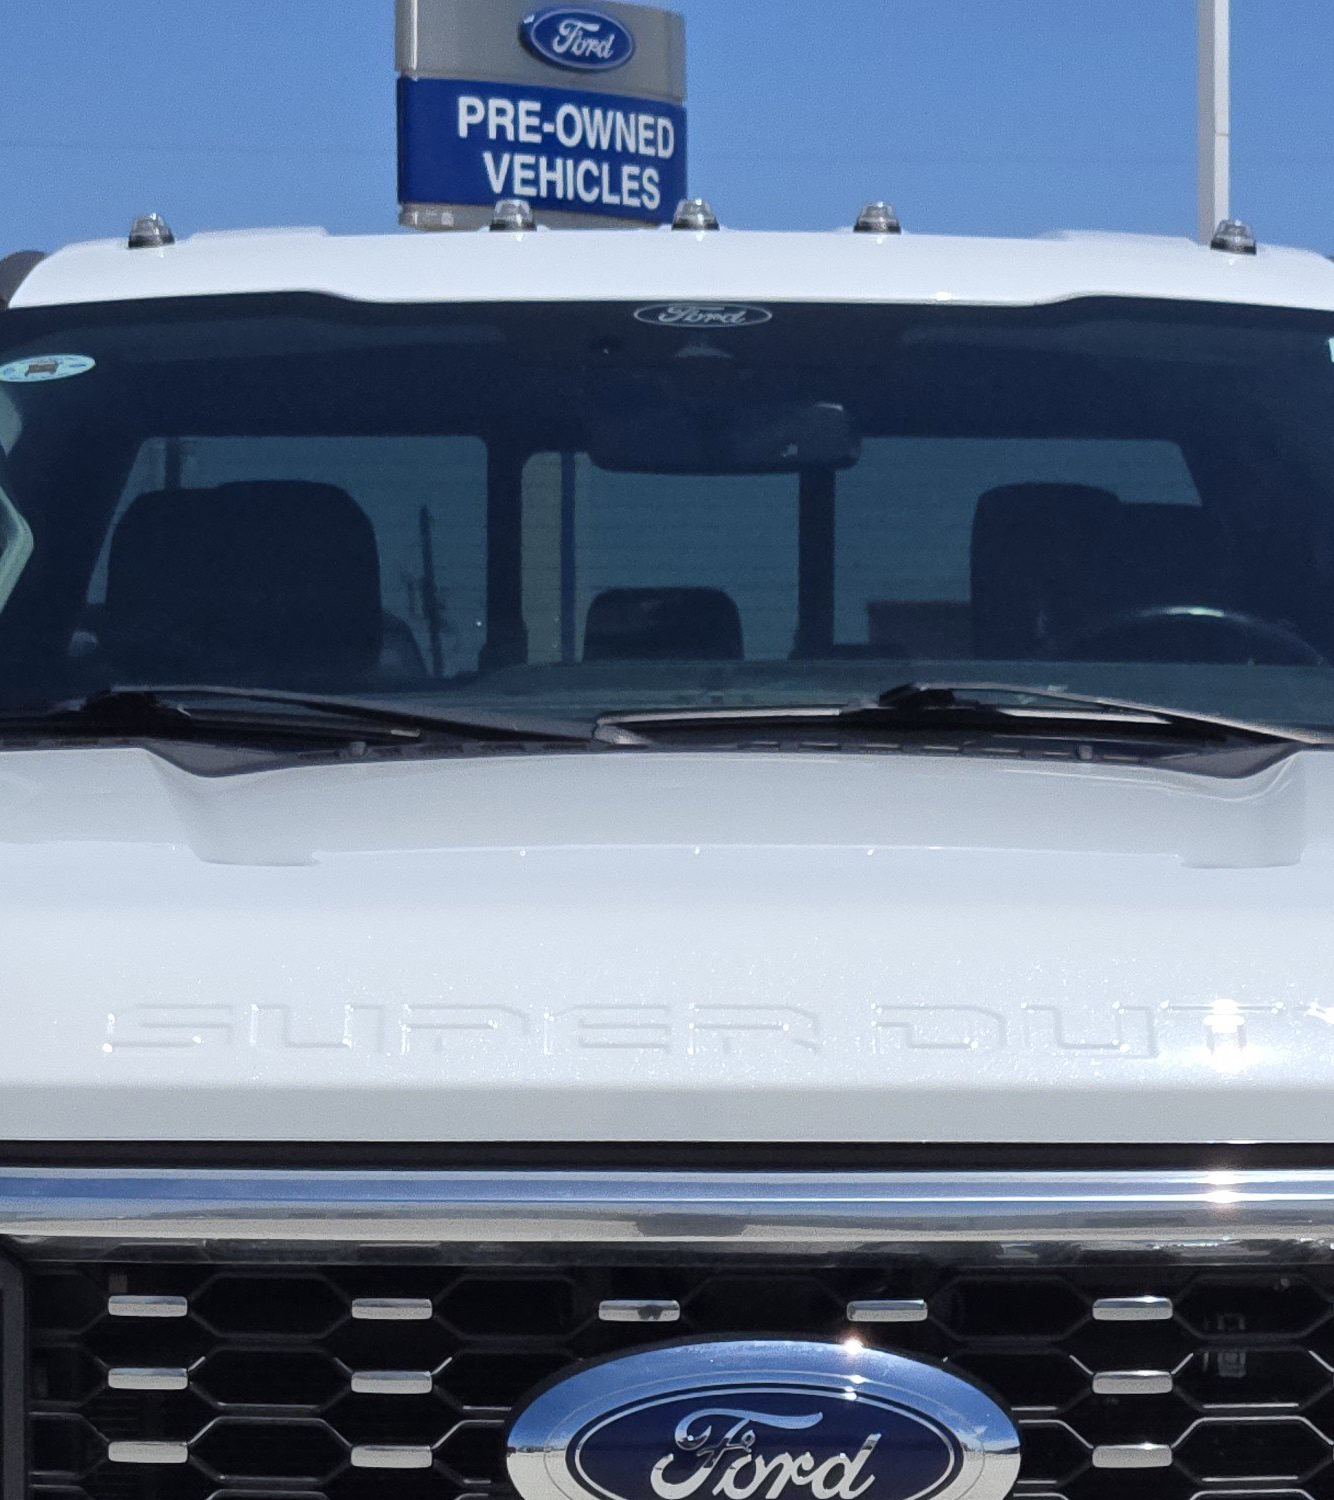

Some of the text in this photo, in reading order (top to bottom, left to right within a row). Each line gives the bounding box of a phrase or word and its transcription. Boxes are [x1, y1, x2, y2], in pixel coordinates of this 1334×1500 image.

[552, 19, 616, 59] Ford
[457, 96, 675, 160] PRE-OWNED
[482, 151, 661, 211] VEHICLES
[657, 305, 749, 325] Ford
[103, 1001, 823, 1057] SUPER
[650, 1407, 882, 1500] Ford
